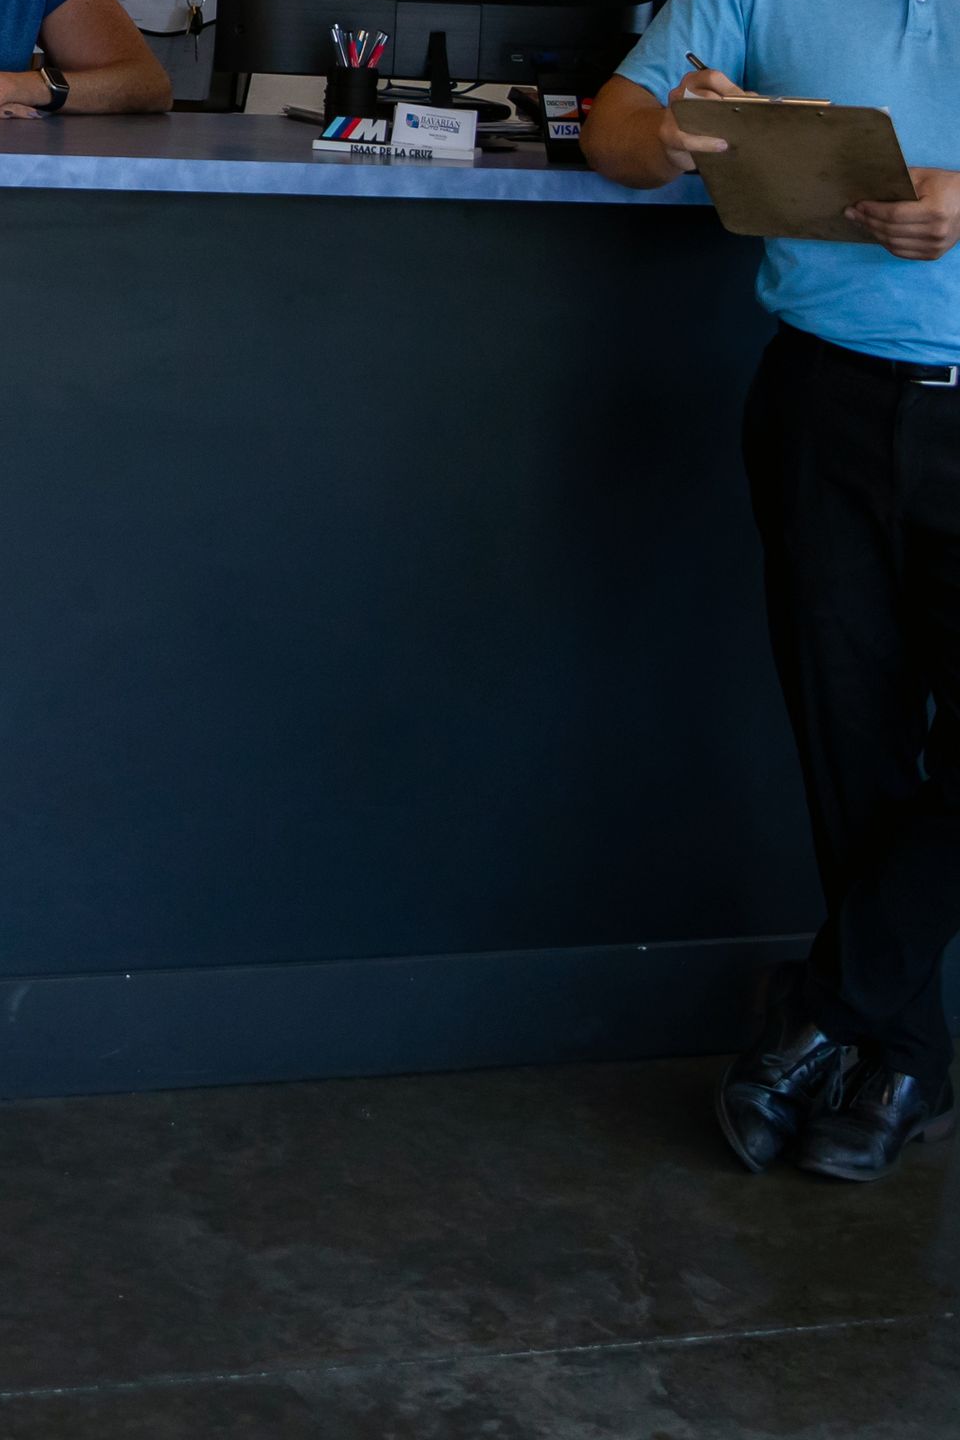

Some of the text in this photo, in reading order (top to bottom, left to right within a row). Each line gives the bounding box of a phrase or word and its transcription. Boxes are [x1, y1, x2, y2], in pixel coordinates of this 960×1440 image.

[420, 116, 461, 129] BAVARIAN
[552, 125, 580, 135] VISA
[350, 144, 433, 160] ISAAC DE LA CRUZ
